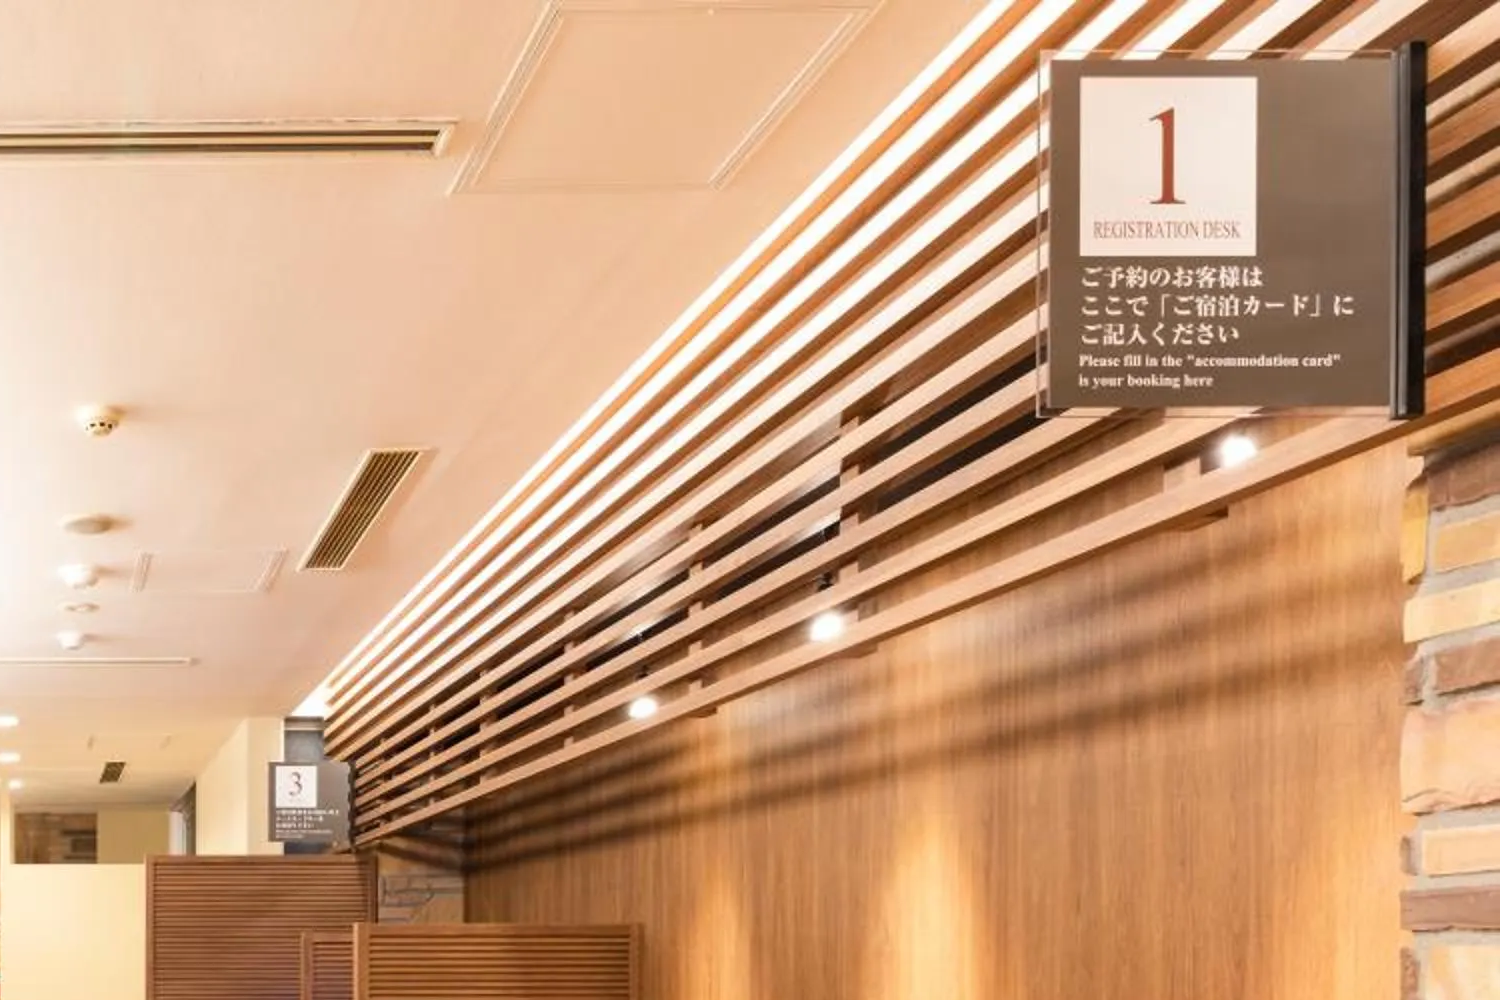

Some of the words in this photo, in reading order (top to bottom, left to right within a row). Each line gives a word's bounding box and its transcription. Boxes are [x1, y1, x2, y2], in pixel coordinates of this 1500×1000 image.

[1149, 106, 1186, 205] 1
[1093, 220, 1199, 239] REGISTRATION
[1202, 220, 1242, 239] DESK
[1081, 265, 1264, 289] ご予約のお客様は
[1081, 293, 1355, 318] ここで「ご宿泊カード」に
[1081, 322, 1240, 346] ご記入ください
[1078, 354, 1121, 367] Please
[1123, 354, 1142, 367] fill
[1145, 354, 1159, 367] in
[1161, 354, 1183, 367] the
[1187, 354, 1299, 367] "accommodation
[1301, 354, 1341, 367] card"
[1078, 374, 1089, 387] is
[1092, 376, 1124, 389] your
[1127, 374, 1181, 389] booking
[1183, 374, 1214, 387] here
[288, 771, 303, 797] 3
